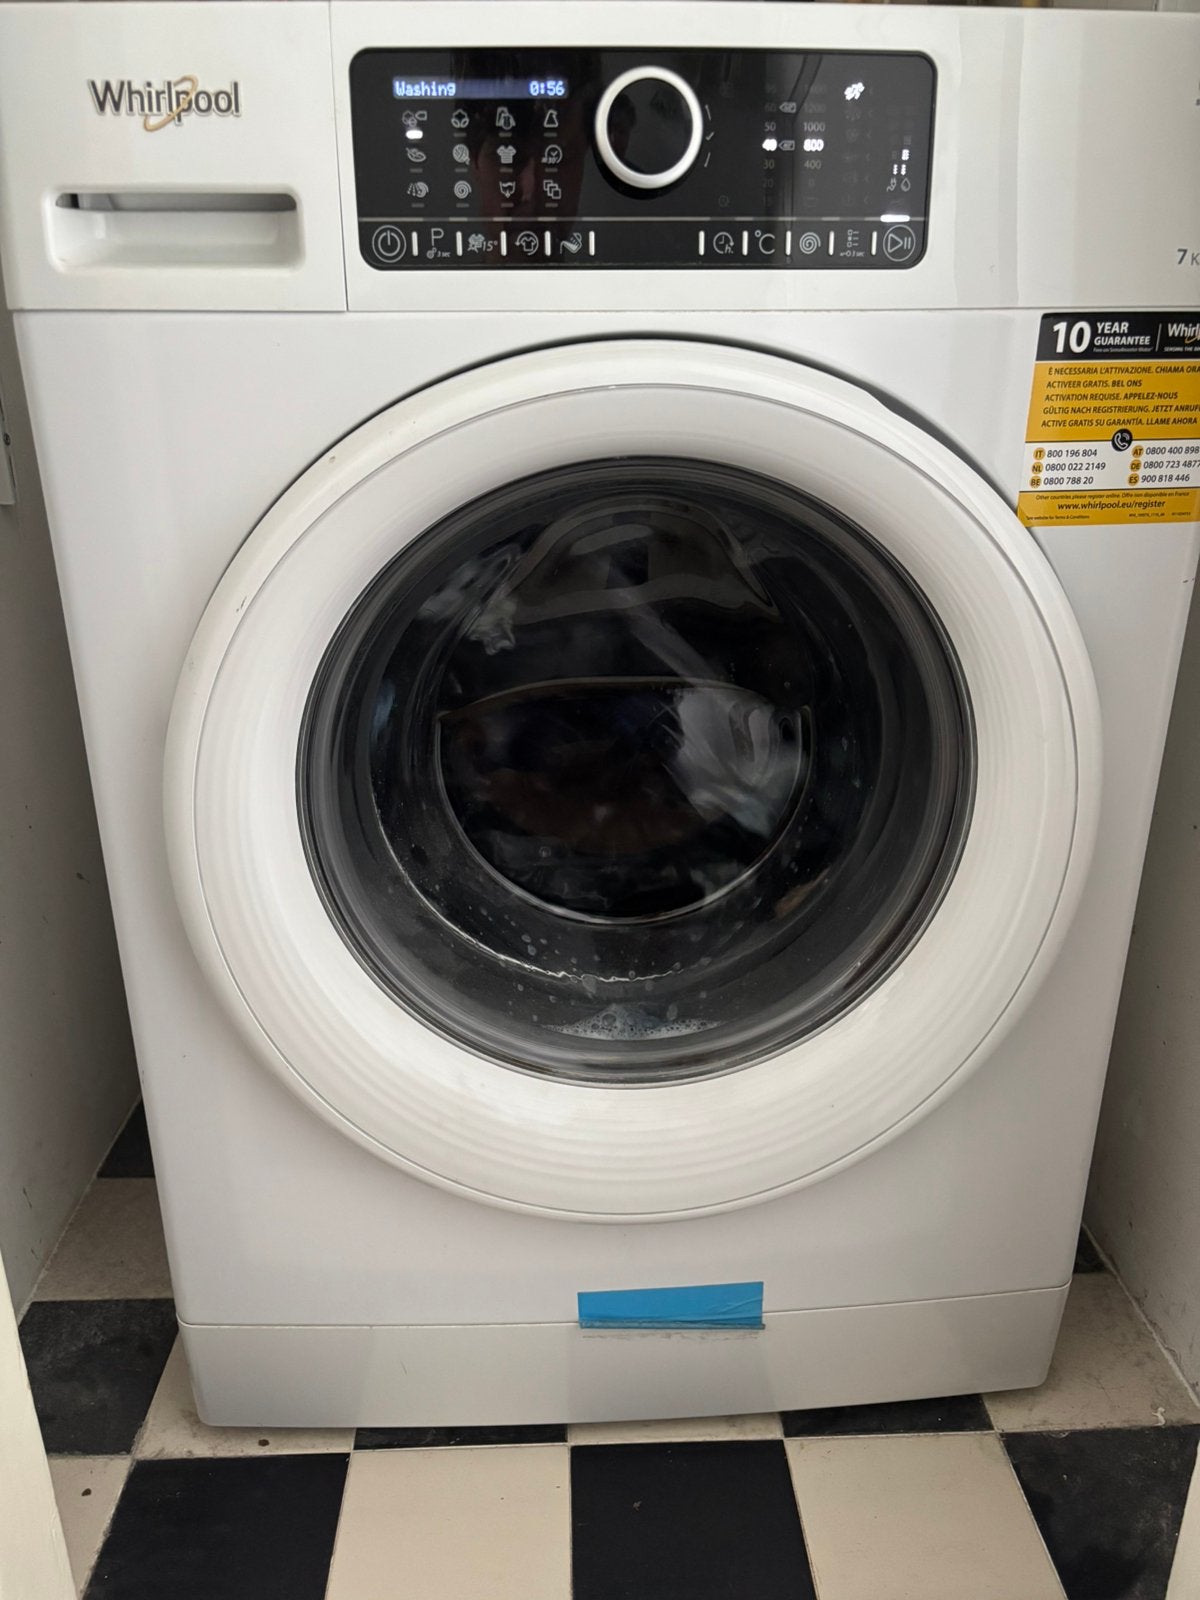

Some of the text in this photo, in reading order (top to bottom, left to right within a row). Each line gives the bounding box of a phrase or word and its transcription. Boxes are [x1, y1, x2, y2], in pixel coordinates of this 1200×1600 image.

[394, 80, 565, 97] Washing 0:56
[88, 76, 241, 128] Whirlpool
[763, 121, 777, 133] 50
[803, 121, 826, 133] 1000
[763, 158, 776, 170] 30
[804, 158, 822, 170] 400
[430, 228, 445, 247] P
[1177, 248, 1200, 266] 7 K
[1053, 321, 1129, 354] 10 YEAR
[1093, 336, 1151, 346] GUARANTEE
[1054, 367, 1098, 376] NECESSARIA
[1099, 366, 1153, 375] L'ATTIVAZIONE.
[1154, 366, 1185, 374] CHIAMA
[1046, 379, 1142, 389] ACTIVEER GRATIS. BEL ONS
[1044, 392, 1178, 402] ACTIVATION REQUISE. APPELEZ-NOUS
[1042, 404, 1200, 415] GÜLTIG NACH REGISTRIERUNG. JETZT ANRUF
[1041, 417, 1197, 428] ACTIVE GRATIS SU GARANTÍA. LLAME AHORA
[1034, 448, 1098, 458] IT 800 196 804
[1132, 446, 1200, 456] AT 0800 400 898
[1031, 462, 1106, 473] NL 0800 022 2149
[1130, 460, 1200, 470] DE 0800 723 4877
[1030, 476, 1094, 487] BE 0800 788 20
[1128, 473, 1190, 483] ES 900 818 446
[1057, 499, 1166, 511] www.whirlpool.eu/register
